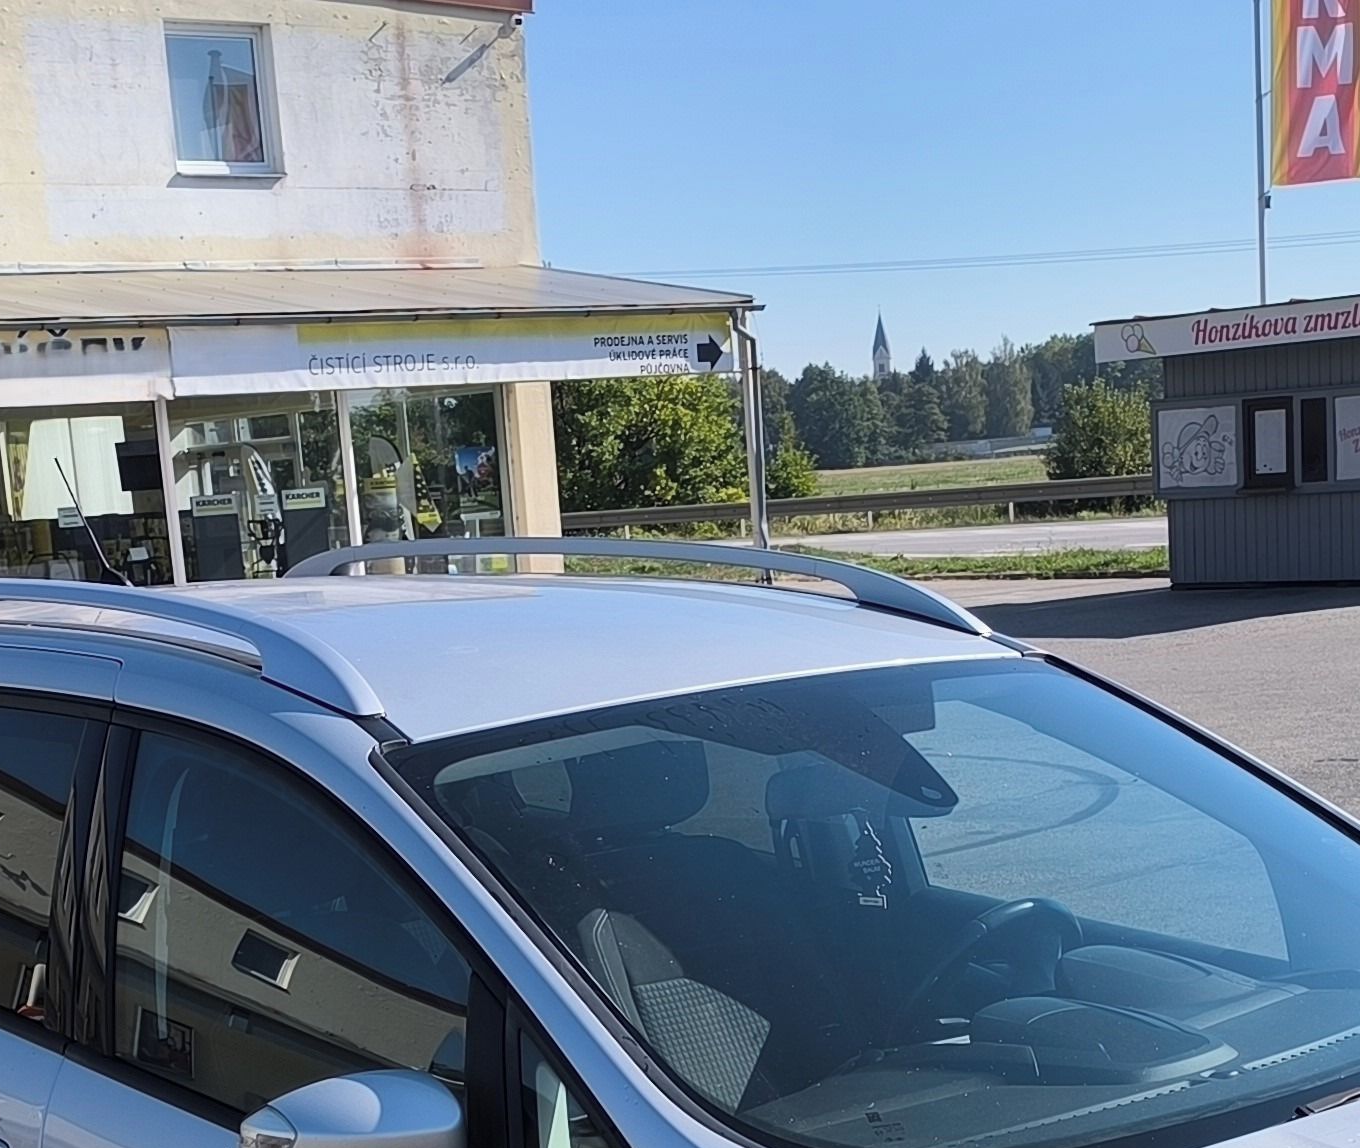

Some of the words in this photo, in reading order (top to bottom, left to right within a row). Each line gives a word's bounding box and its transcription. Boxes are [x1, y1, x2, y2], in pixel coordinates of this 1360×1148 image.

[1295, 0, 1354, 158] MA
[594, 335, 644, 347] PRODEJNA
[647, 336, 654, 345] A
[656, 334, 688, 345] SERVIS
[1192, 313, 1296, 345] Honzíkova
[308, 352, 366, 376] ČISTÍCÍ
[372, 353, 436, 373] STROJE
[441, 355, 479, 371] s.r.o.
[659, 347, 689, 359] PRÁCE
